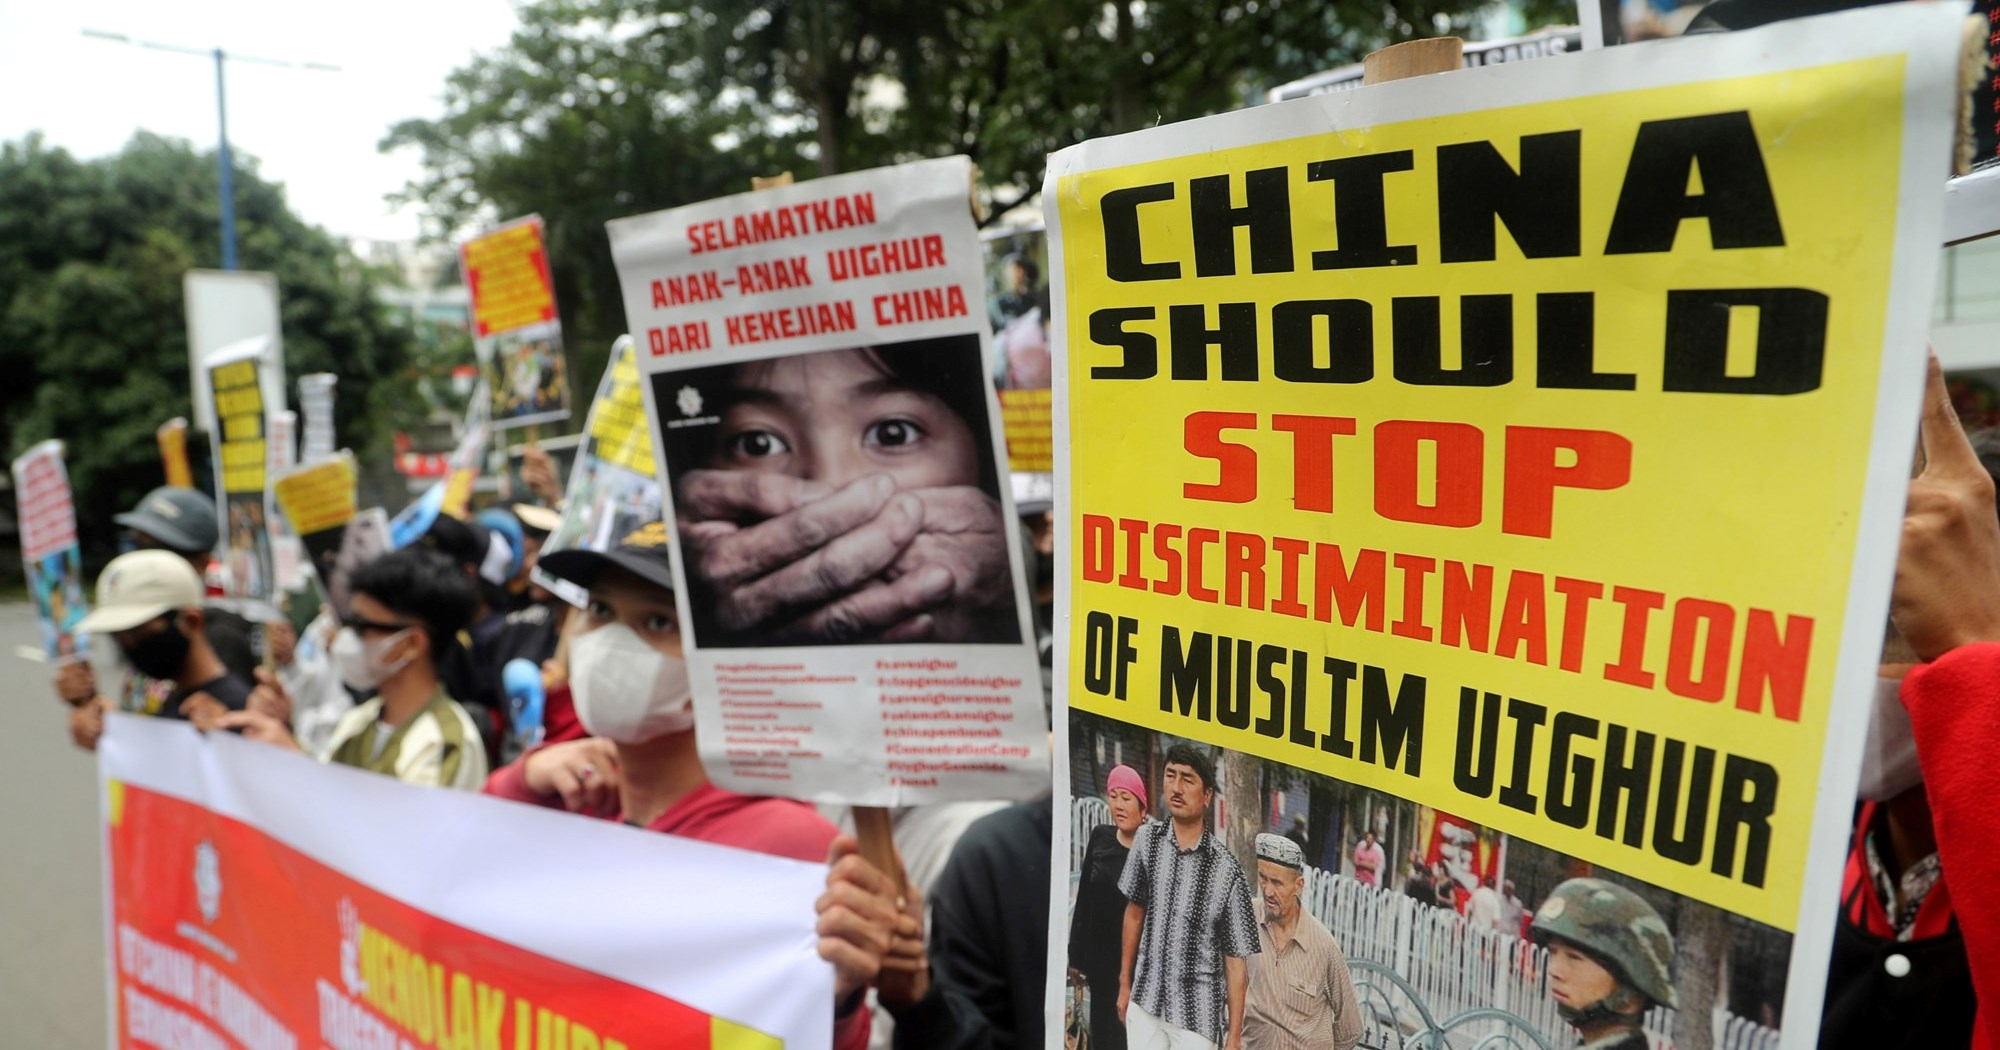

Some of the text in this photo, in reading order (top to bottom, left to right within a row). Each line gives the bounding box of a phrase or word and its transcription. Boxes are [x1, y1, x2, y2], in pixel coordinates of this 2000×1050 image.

[687, 192, 877, 254] SELAMATKAN
[1100, 110, 1787, 282] CHINA
[648, 285, 969, 357] DARI KEKEJIAN CHINA
[650, 234, 946, 309] ANAK-ANAK UIGHUR
[1089, 287, 1830, 395] SHOULD
[1183, 411, 1633, 539] STOP
[1083, 513, 1815, 723] DISCRIMINATION
[1084, 610, 1138, 701] OF
[1159, 624, 1427, 778] MUSLIM
[1453, 686, 1780, 890] UIGHUR
